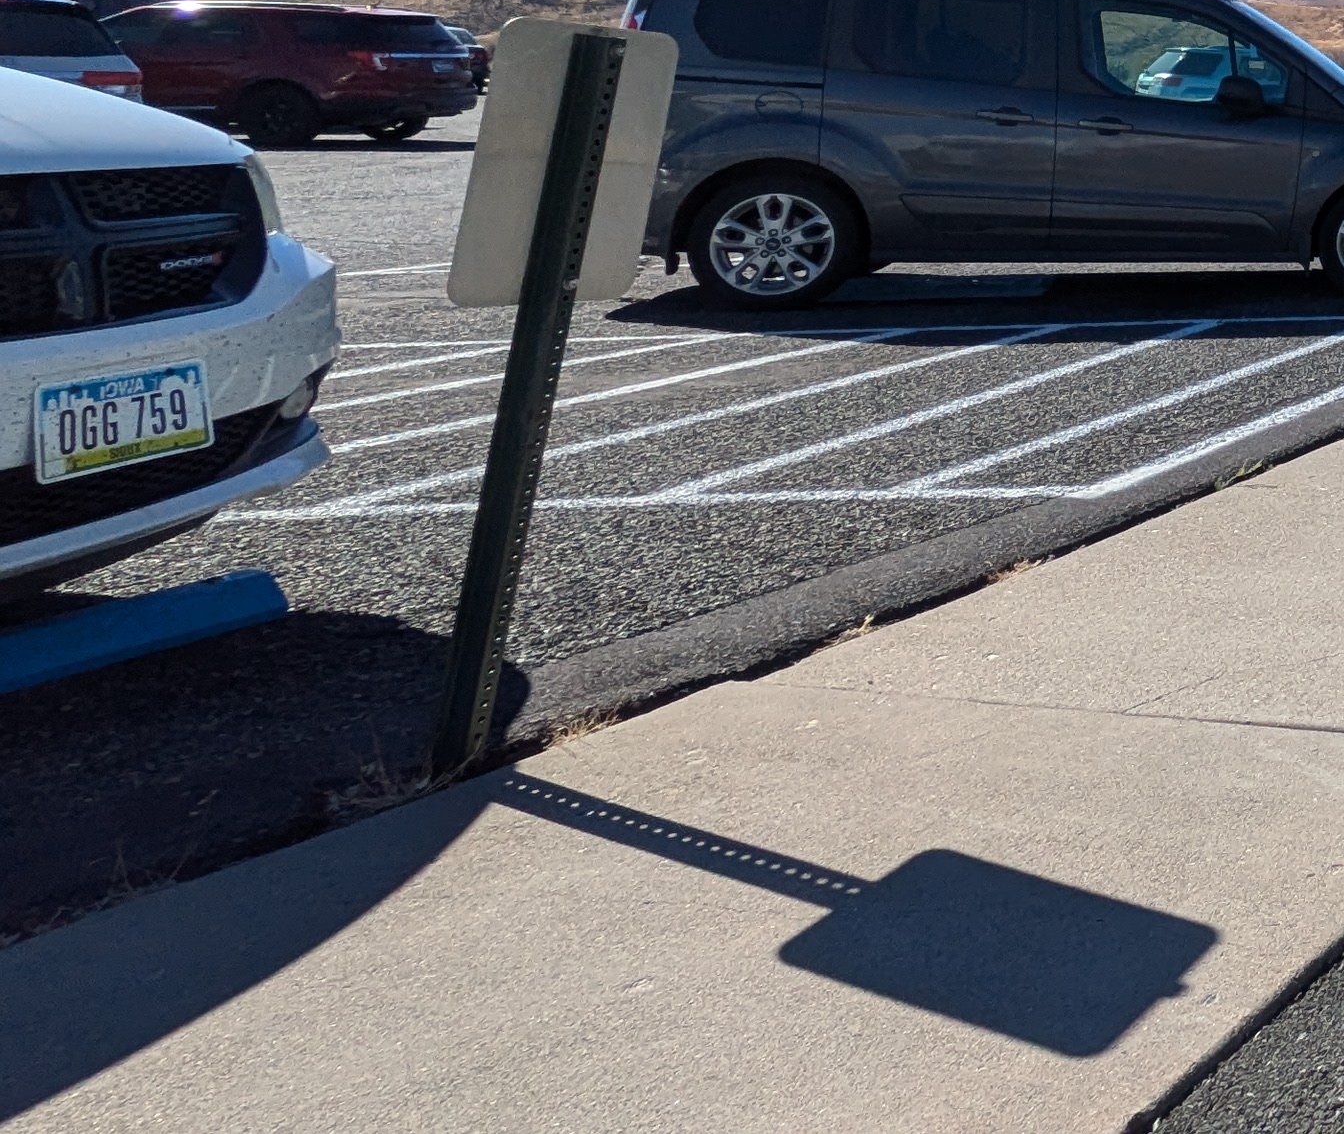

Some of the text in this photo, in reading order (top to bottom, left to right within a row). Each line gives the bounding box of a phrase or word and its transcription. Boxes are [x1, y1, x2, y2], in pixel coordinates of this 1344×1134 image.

[100, 377, 145, 399] IOWA
[58, 388, 188, 456] OGG 759
